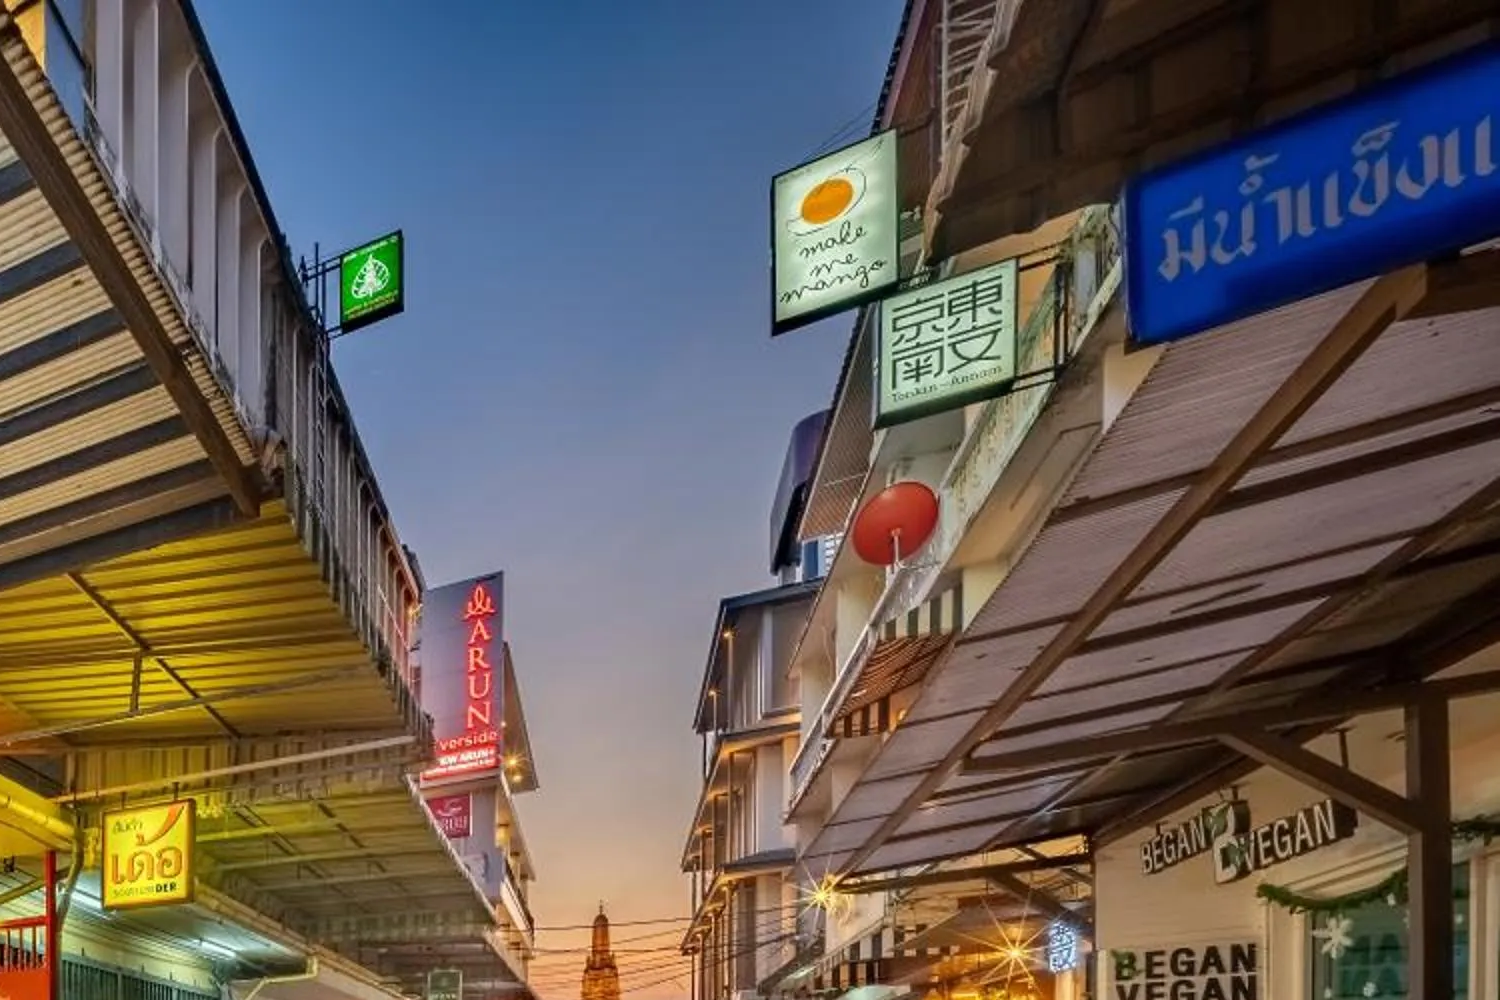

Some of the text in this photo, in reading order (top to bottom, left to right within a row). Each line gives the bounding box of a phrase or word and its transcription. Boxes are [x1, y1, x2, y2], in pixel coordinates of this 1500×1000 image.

[800, 220, 867, 258] make
[780, 259, 888, 304] mango
[810, 253, 859, 278] me
[467, 619, 492, 729] ARUN
[433, 730, 498, 752] verside
[1140, 799, 1338, 874] BEGAN VEGAN
[1111, 943, 1257, 981] BEGAN
